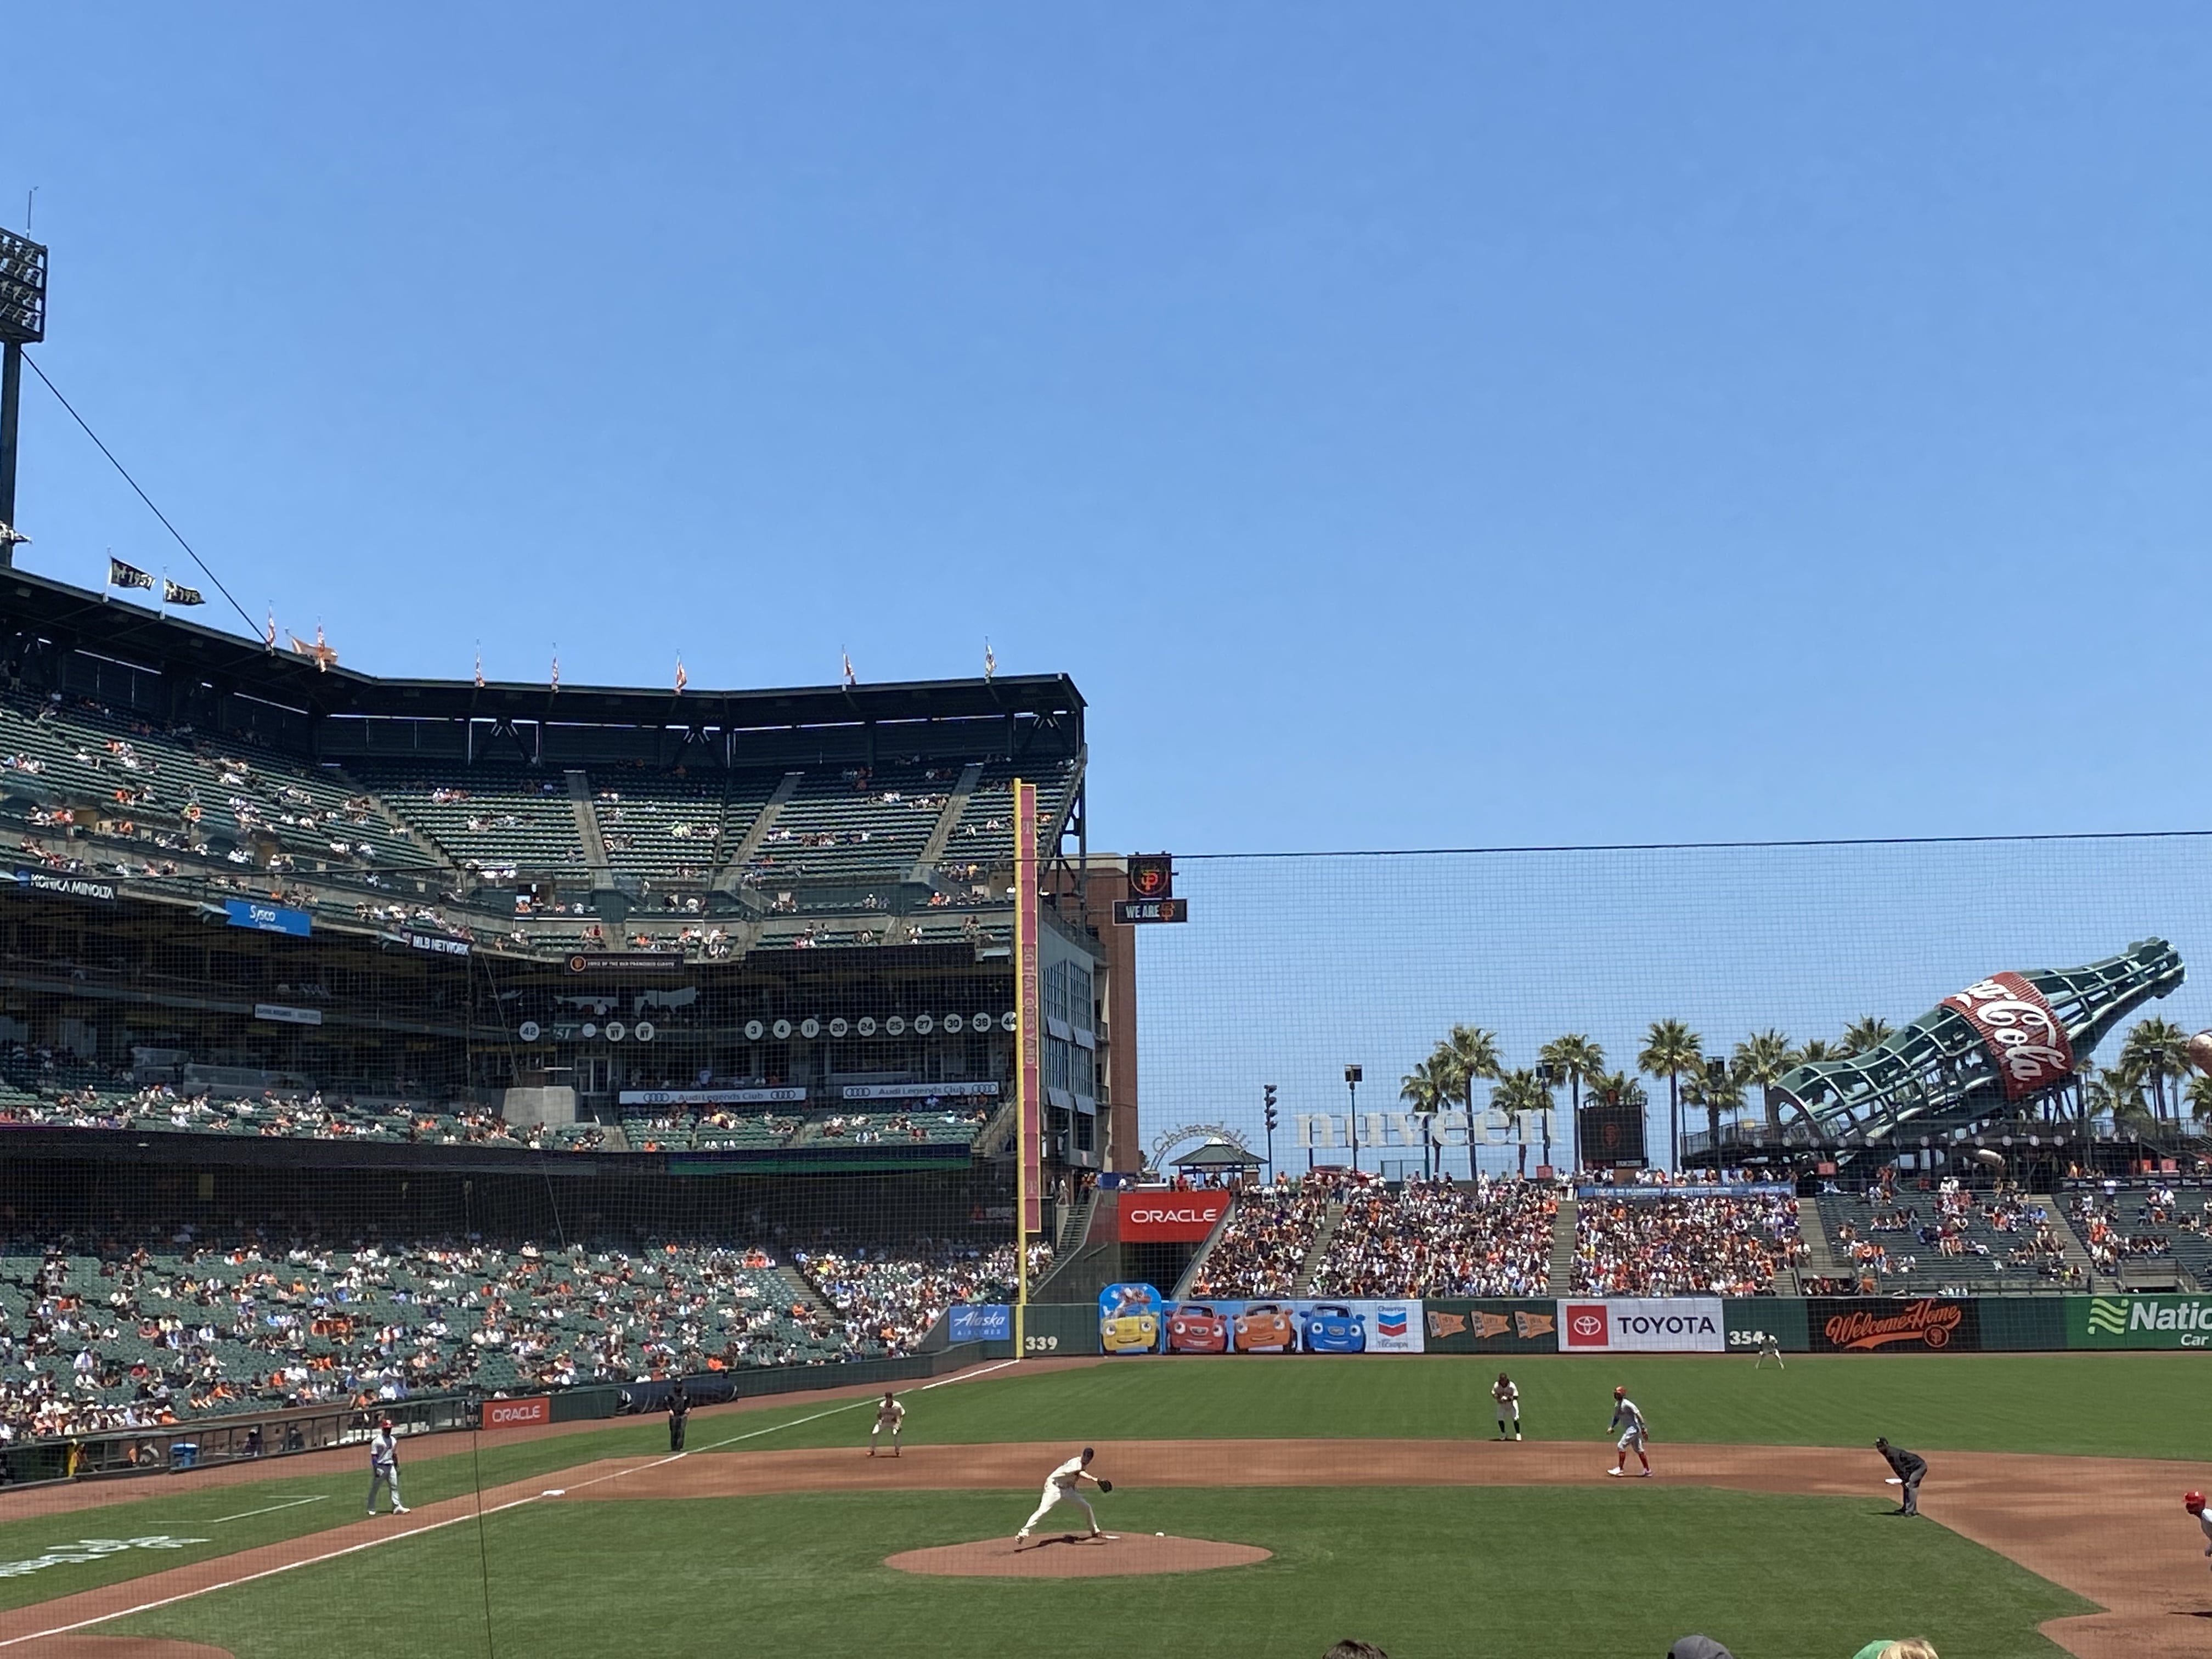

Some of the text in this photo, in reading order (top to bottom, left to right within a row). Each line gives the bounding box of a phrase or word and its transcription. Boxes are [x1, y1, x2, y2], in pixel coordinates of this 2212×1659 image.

[31, 874, 114, 900] KONICA MINOLTA
[250, 905, 275, 922] Sysco
[1126, 905, 1141, 918] WE
[1142, 905, 1160, 918] ARE
[413, 935, 430, 949] MLB
[431, 939, 469, 956] NETWORK
[1024, 946, 1035, 1065] 5G THAT GOES YARD
[832, 1023, 844, 1032] 20
[860, 1023, 873, 1031] 24
[889, 1021, 902, 1030] 25
[918, 1020, 929, 1029] 27
[947, 1019, 959, 1028] 30
[1004, 1017, 1017, 1025] 44
[522, 1027, 537, 1036] 42
[751, 1026, 757, 1034] 3
[806, 1024, 814, 1032] 11
[1977, 1000, 2067, 1081] Cola
[702, 1092, 741, 1102] Legends
[742, 1092, 763, 1100] Club
[878, 1087, 900, 1096] Audi
[903, 1086, 941, 1096] Legends
[1294, 1109, 1562, 1148] nuveen
[1131, 1209, 1217, 1223] ORACLE
[953, 1311, 1006, 1328] Alaska
[1617, 1317, 1716, 1334] TOYOTA
[1825, 1299, 1961, 1344] Welcome Home
[1025, 1336, 1058, 1350] 339
[1729, 1330, 1764, 1345] 354
[2181, 1334, 2209, 1346] Car
[492, 1405, 541, 1423] ORACLE
